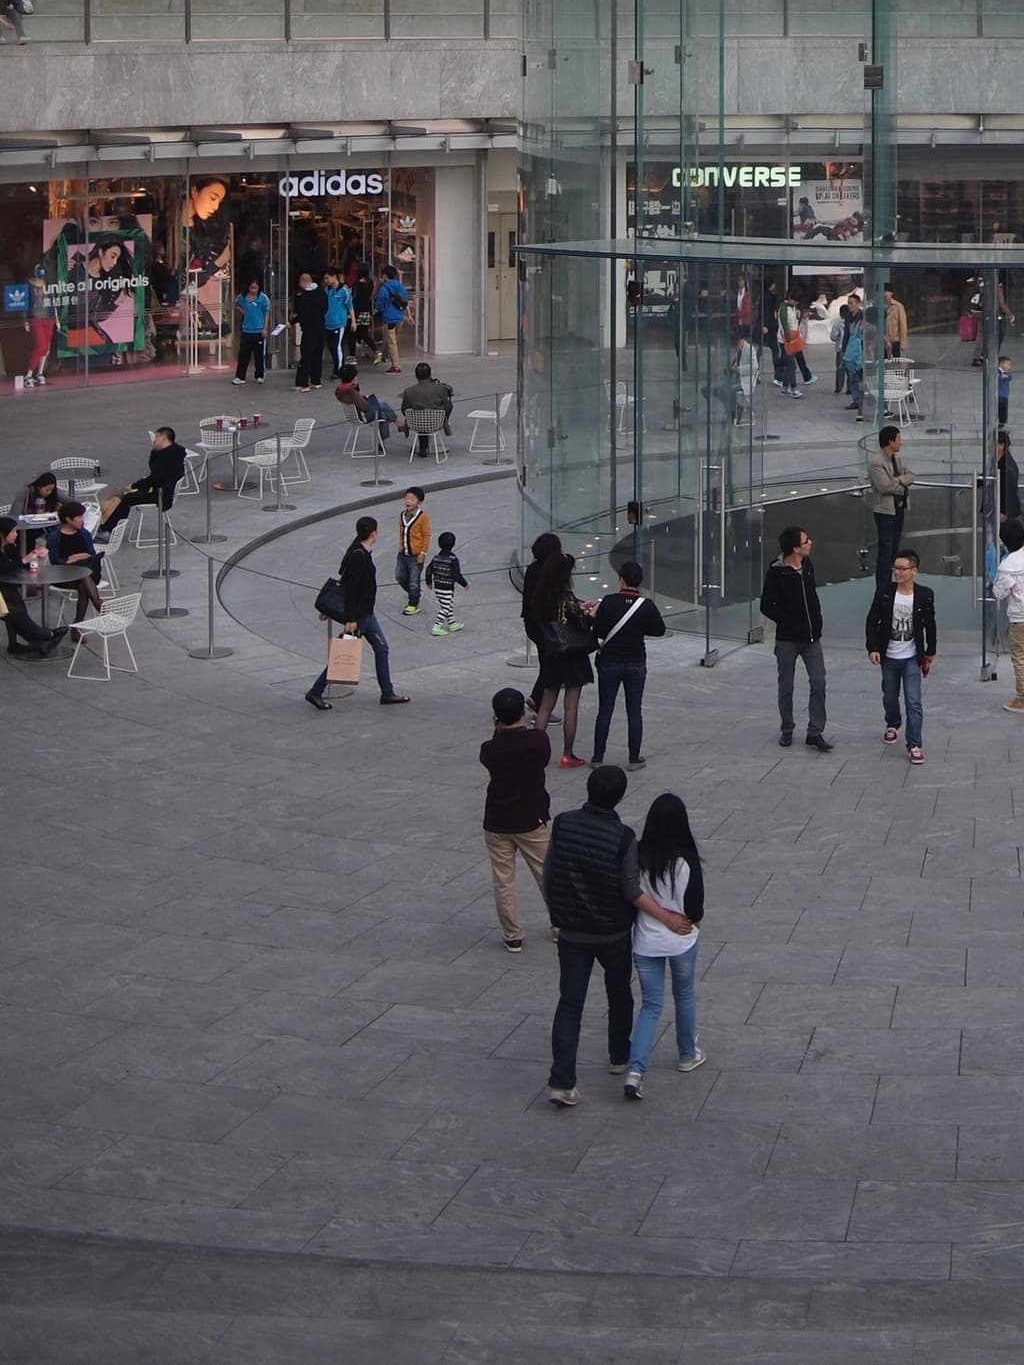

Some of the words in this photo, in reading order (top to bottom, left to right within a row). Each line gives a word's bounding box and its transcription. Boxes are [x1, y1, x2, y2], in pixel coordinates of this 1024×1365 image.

[279, 169, 384, 197] adidas
[672, 167, 801, 187] CONVERSE
[43, 280, 75, 294] unite
[95, 275, 149, 292] originals
